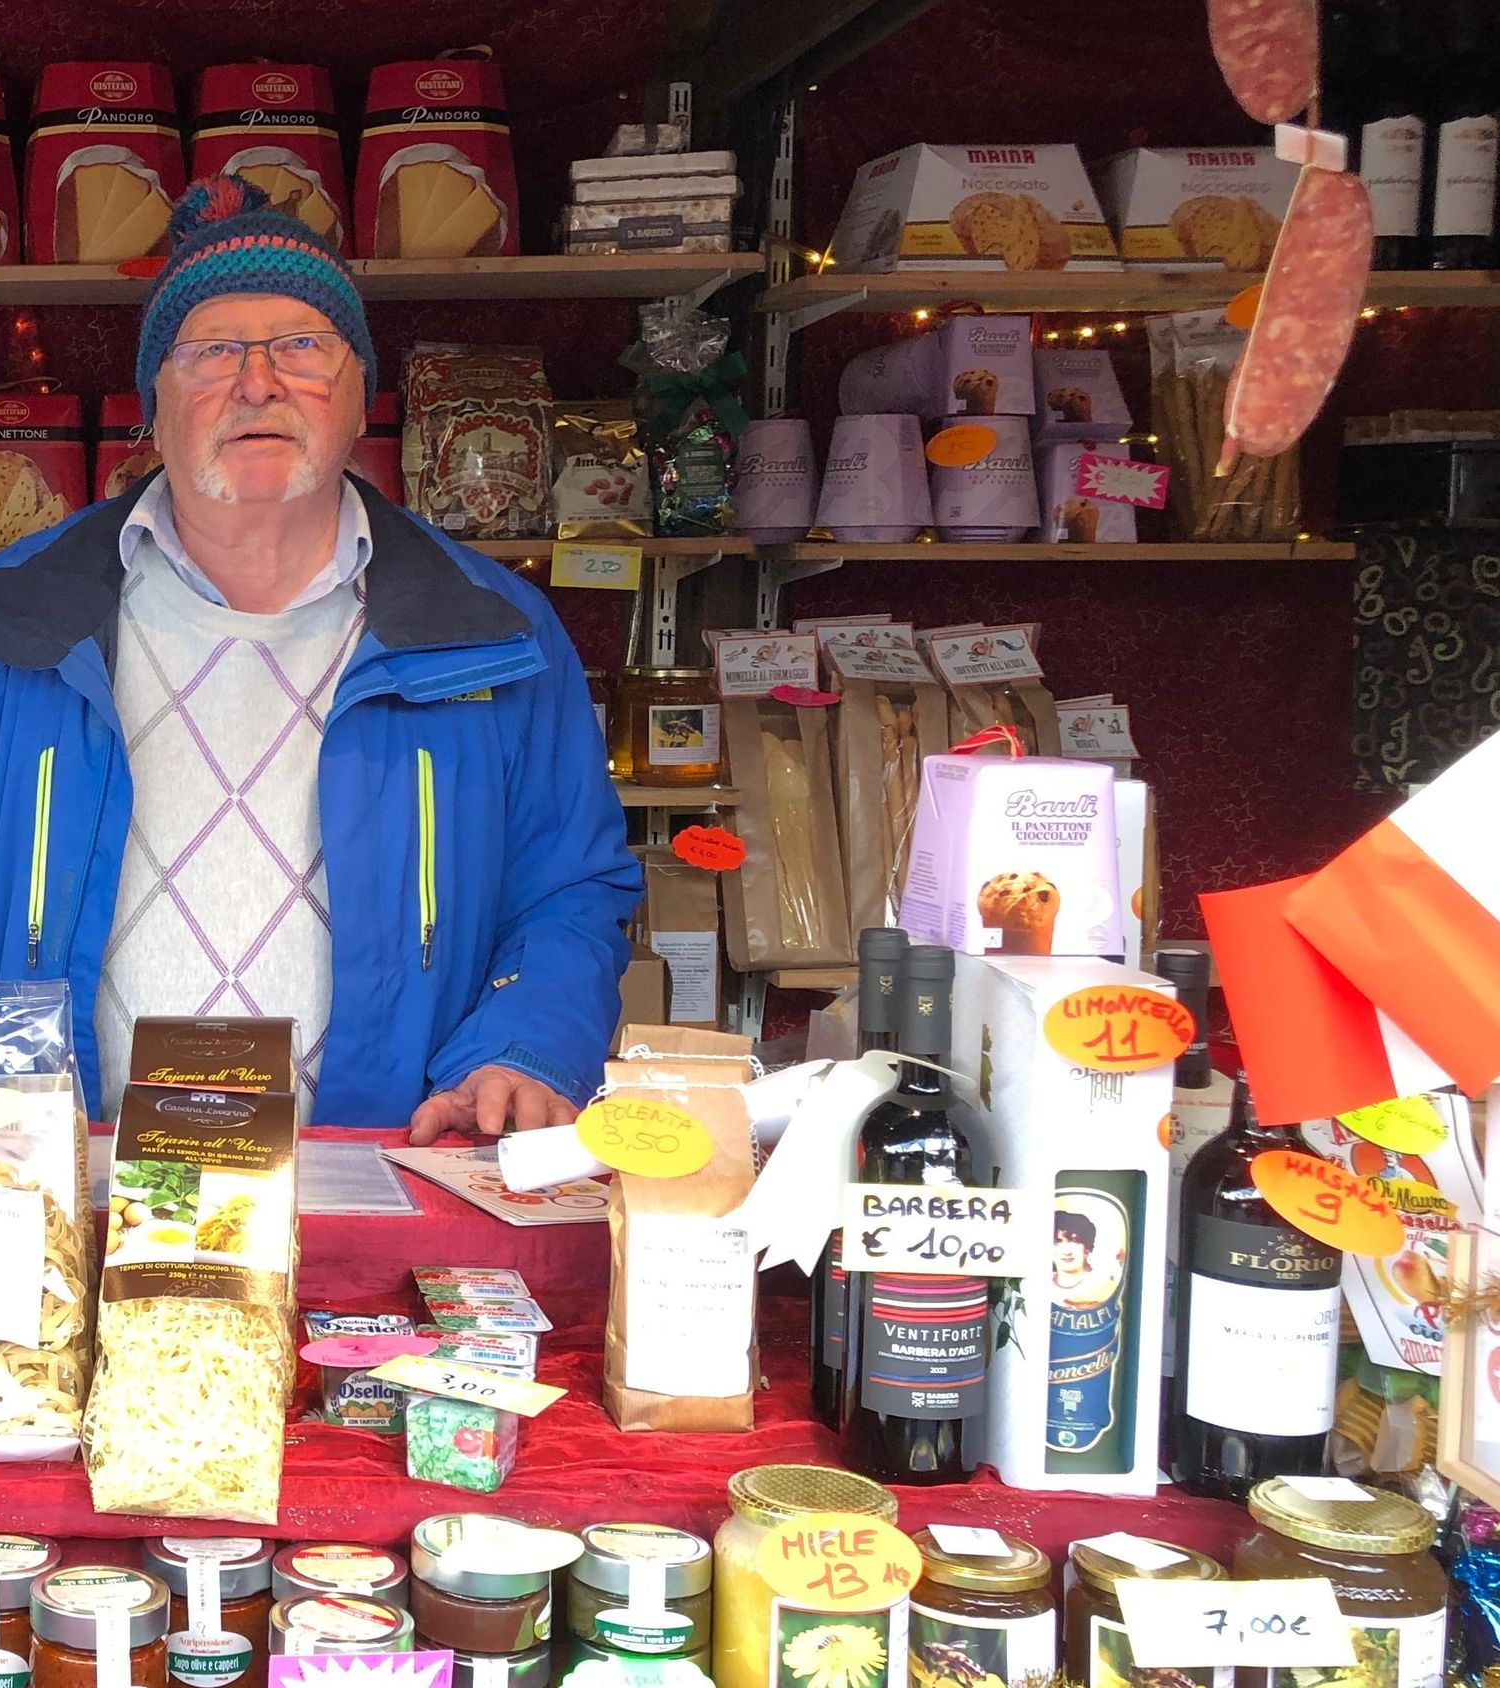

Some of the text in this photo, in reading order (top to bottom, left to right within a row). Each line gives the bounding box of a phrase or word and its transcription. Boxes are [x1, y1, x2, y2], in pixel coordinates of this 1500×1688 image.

[967, 149, 1036, 164] MAINA
[1005, 789, 1099, 818] Bauli
[1011, 821, 1093, 832] IL PANETTONE
[1015, 831, 1089, 841] CIOCCOLATO
[1082, 1019, 1139, 1058] 11
[147, 1067, 206, 1085] Tajarin
[1089, 1071, 1124, 1105] 1899
[164, 1103, 203, 1114] Cascina
[600, 1103, 696, 1131] POLENTA
[136, 1130, 201, 1150] Tajarin
[600, 1124, 680, 1154] 3,50
[177, 1149, 207, 1157] SEMOLA
[207, 1150, 215, 1158] DI
[216, 1152, 244, 1161] GRANO
[245, 1155, 266, 1163] DURO
[184, 1156, 222, 1164] ALL'UOVO
[1393, 1187, 1449, 1212] Mauro
[863, 1194, 1013, 1224] BARBERA
[1311, 1193, 1344, 1226] 9
[861, 1226, 1006, 1268] € 10,00
[119, 1264, 144, 1272] TEMPO
[154, 1262, 230, 1273] COTTURA/COOKING
[1229, 1252, 1334, 1272] FLORIO
[168, 1271, 187, 1280] 250g
[1050, 1306, 1112, 1331] AMALFI
[882, 1321, 983, 1343] VENTIFORTI
[891, 1343, 948, 1358] BARBERA
[948, 1344, 976, 1358] D'ASTI
[929, 1366, 948, 1375] 2023
[339, 1382, 397, 1400] Osella
[440, 1372, 497, 1397] 3,00
[926, 1392, 959, 1400] BARBERA
[359, 1418, 387, 1426] TARTUFO
[780, 1528, 878, 1560] MIELE
[59, 1578, 77, 1586] Sugo
[100, 1576, 127, 1585] capperi
[807, 1562, 869, 1600] 13
[612, 1632, 645, 1643] pomodori
[646, 1634, 664, 1643] verdi
[671, 1634, 686, 1643] fichi
[628, 1627, 664, 1636] Composta
[173, 1656, 190, 1672] Sugo
[190, 1657, 208, 1671] olive
[214, 1656, 239, 1672] capperi
